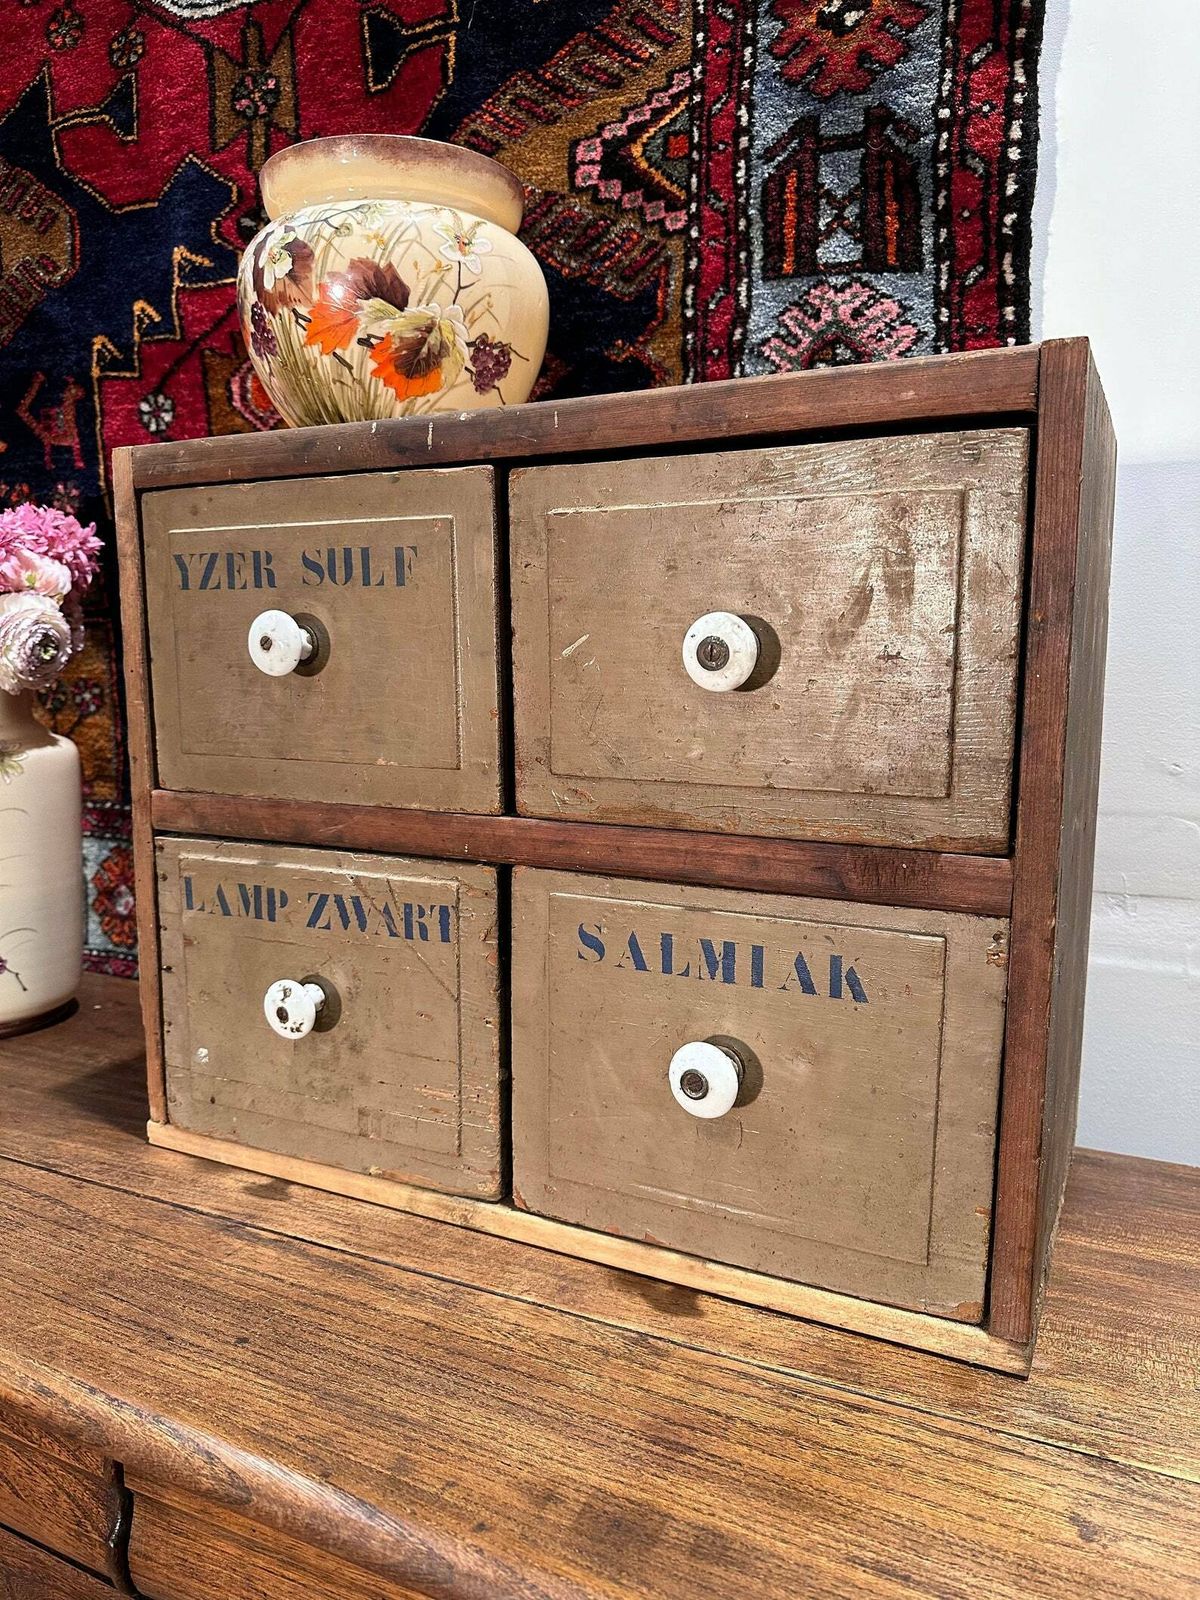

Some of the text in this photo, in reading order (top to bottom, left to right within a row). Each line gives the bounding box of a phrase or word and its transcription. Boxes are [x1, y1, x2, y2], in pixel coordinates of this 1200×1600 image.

[173, 545, 418, 590] YZER SULF
[184, 876, 453, 943] LAMP ZWART
[577, 923, 869, 1003] SALMIAK
